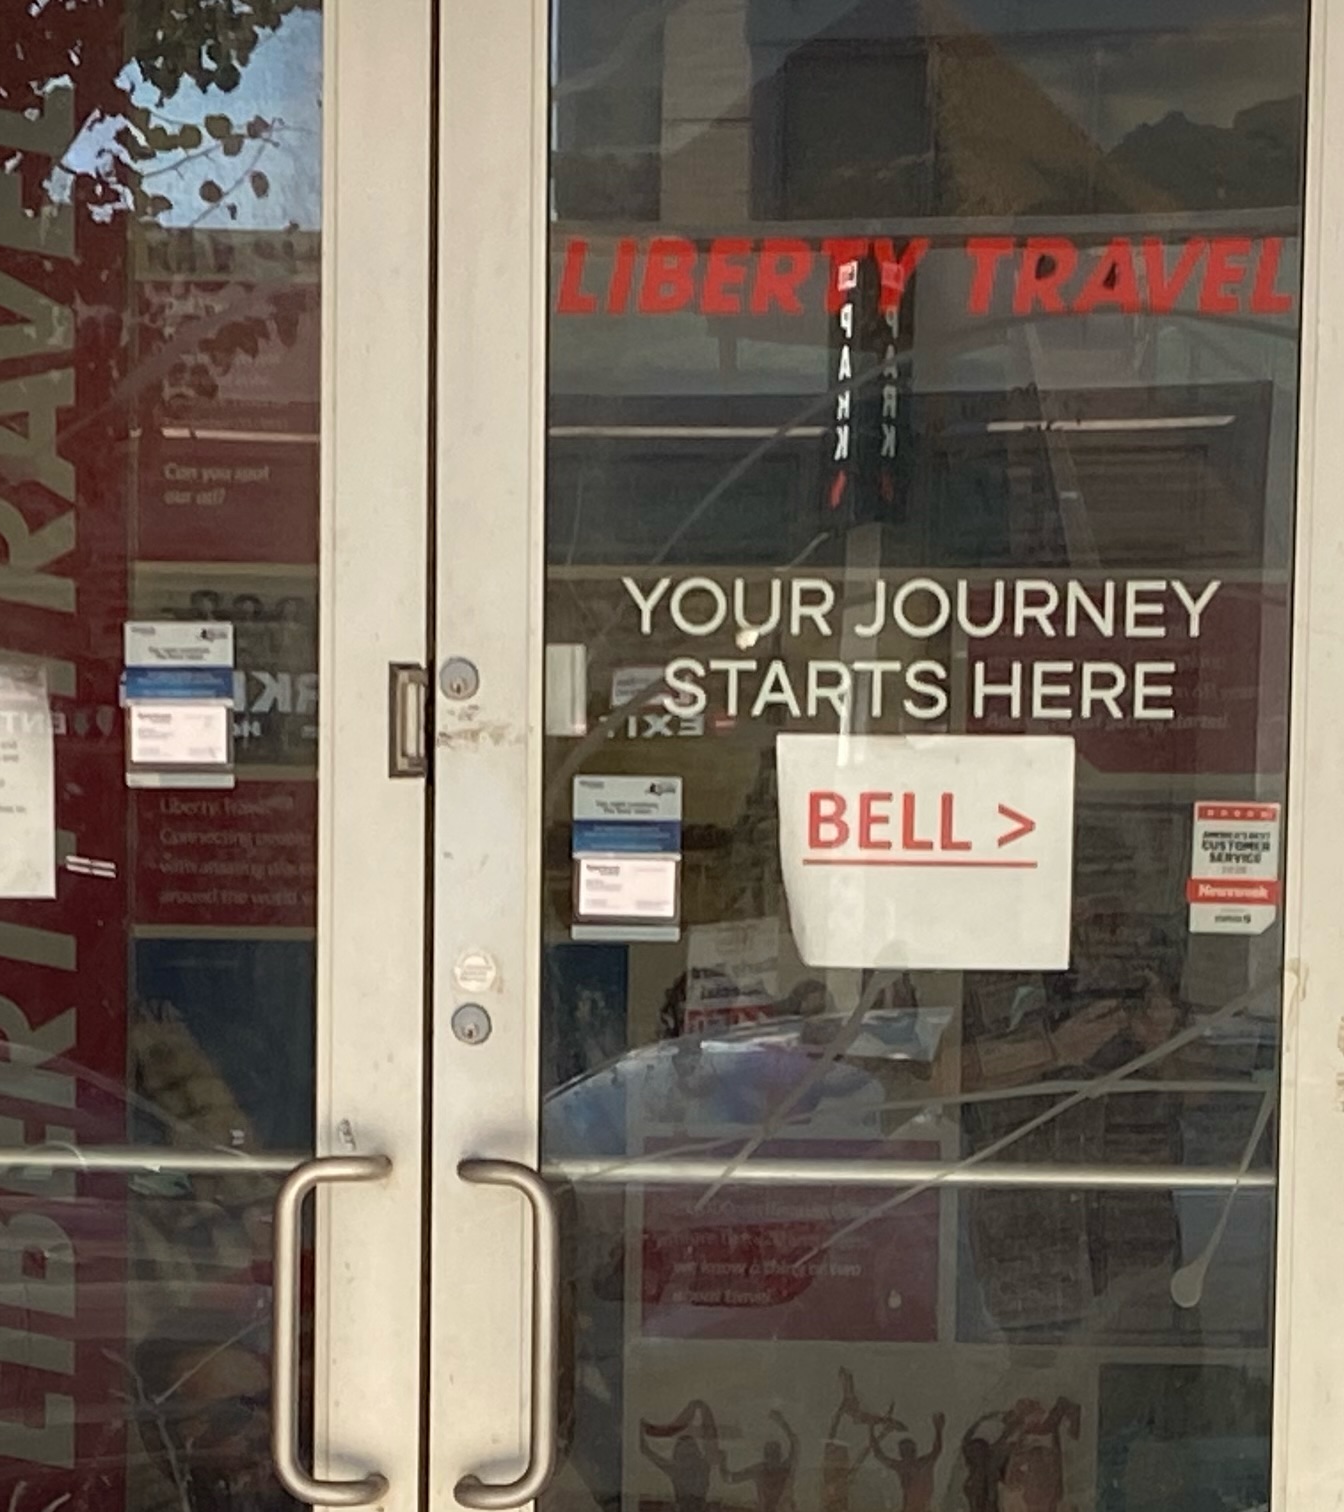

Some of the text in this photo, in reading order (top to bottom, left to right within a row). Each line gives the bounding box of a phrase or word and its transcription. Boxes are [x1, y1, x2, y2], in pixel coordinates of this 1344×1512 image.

[556, 234, 1294, 317] LIBERTY TRAVEL
[623, 576, 1222, 640] YOUR JOURNEY
[663, 658, 1176, 720] STARTS HERE
[807, 791, 973, 852] BELL
